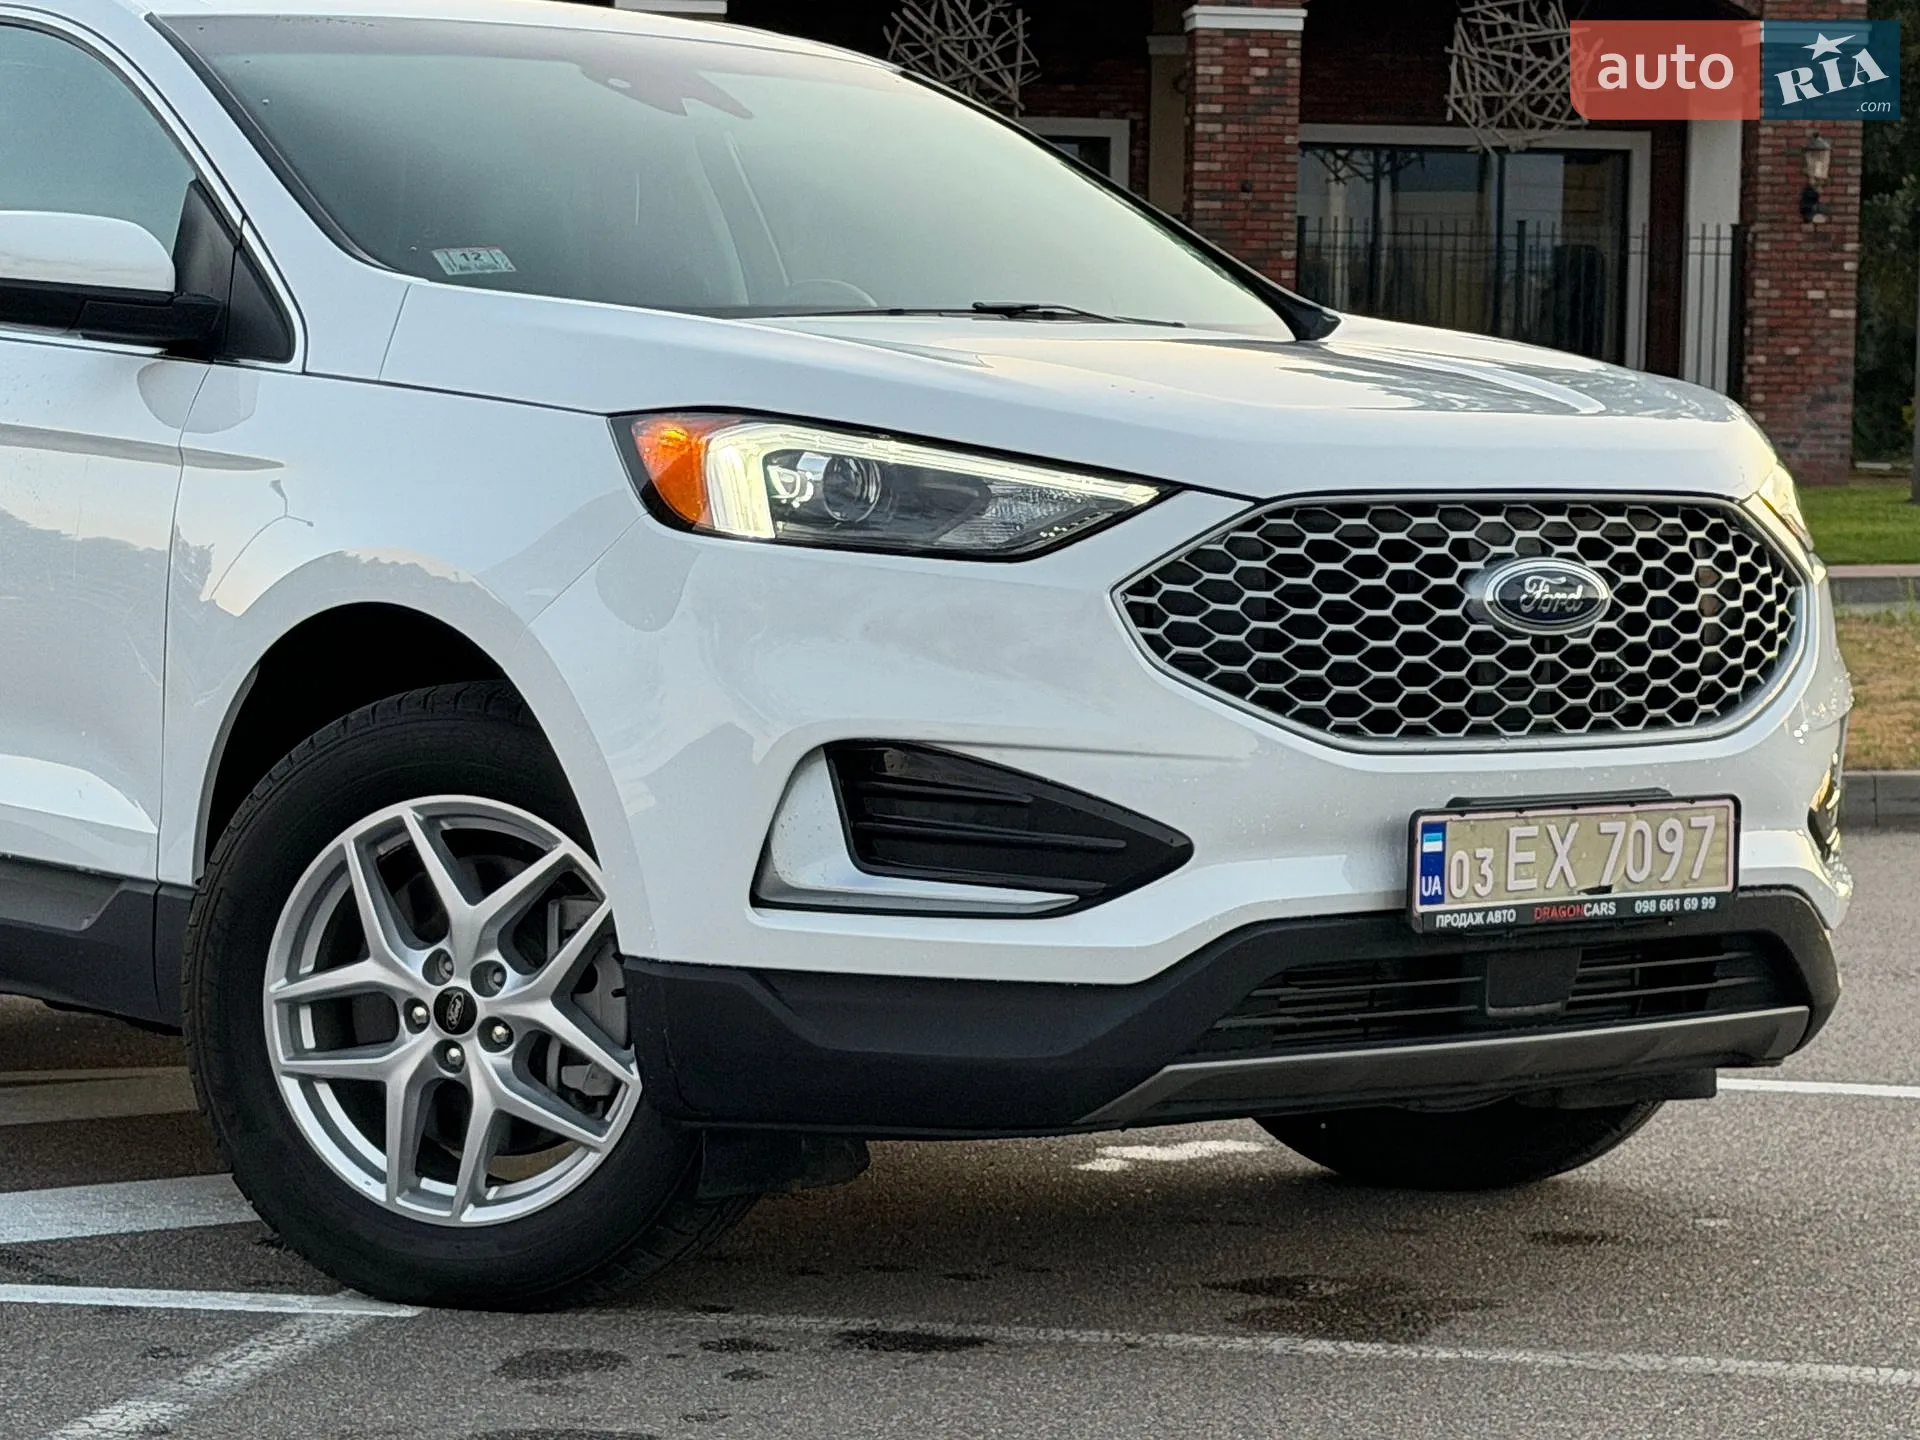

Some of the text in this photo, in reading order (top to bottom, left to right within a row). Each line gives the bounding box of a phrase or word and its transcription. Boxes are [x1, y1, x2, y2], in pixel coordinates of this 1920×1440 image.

[1520, 575, 1584, 613] Ford
[1450, 815, 1717, 899] 03 EX 7097
[1421, 875, 1443, 897] UA
[1534, 901, 1617, 921] DRAGONCARS
[1635, 896, 1717, 914] 098 661 69 99
[1435, 908, 1517, 929] ПРОДАЖ АВТО
